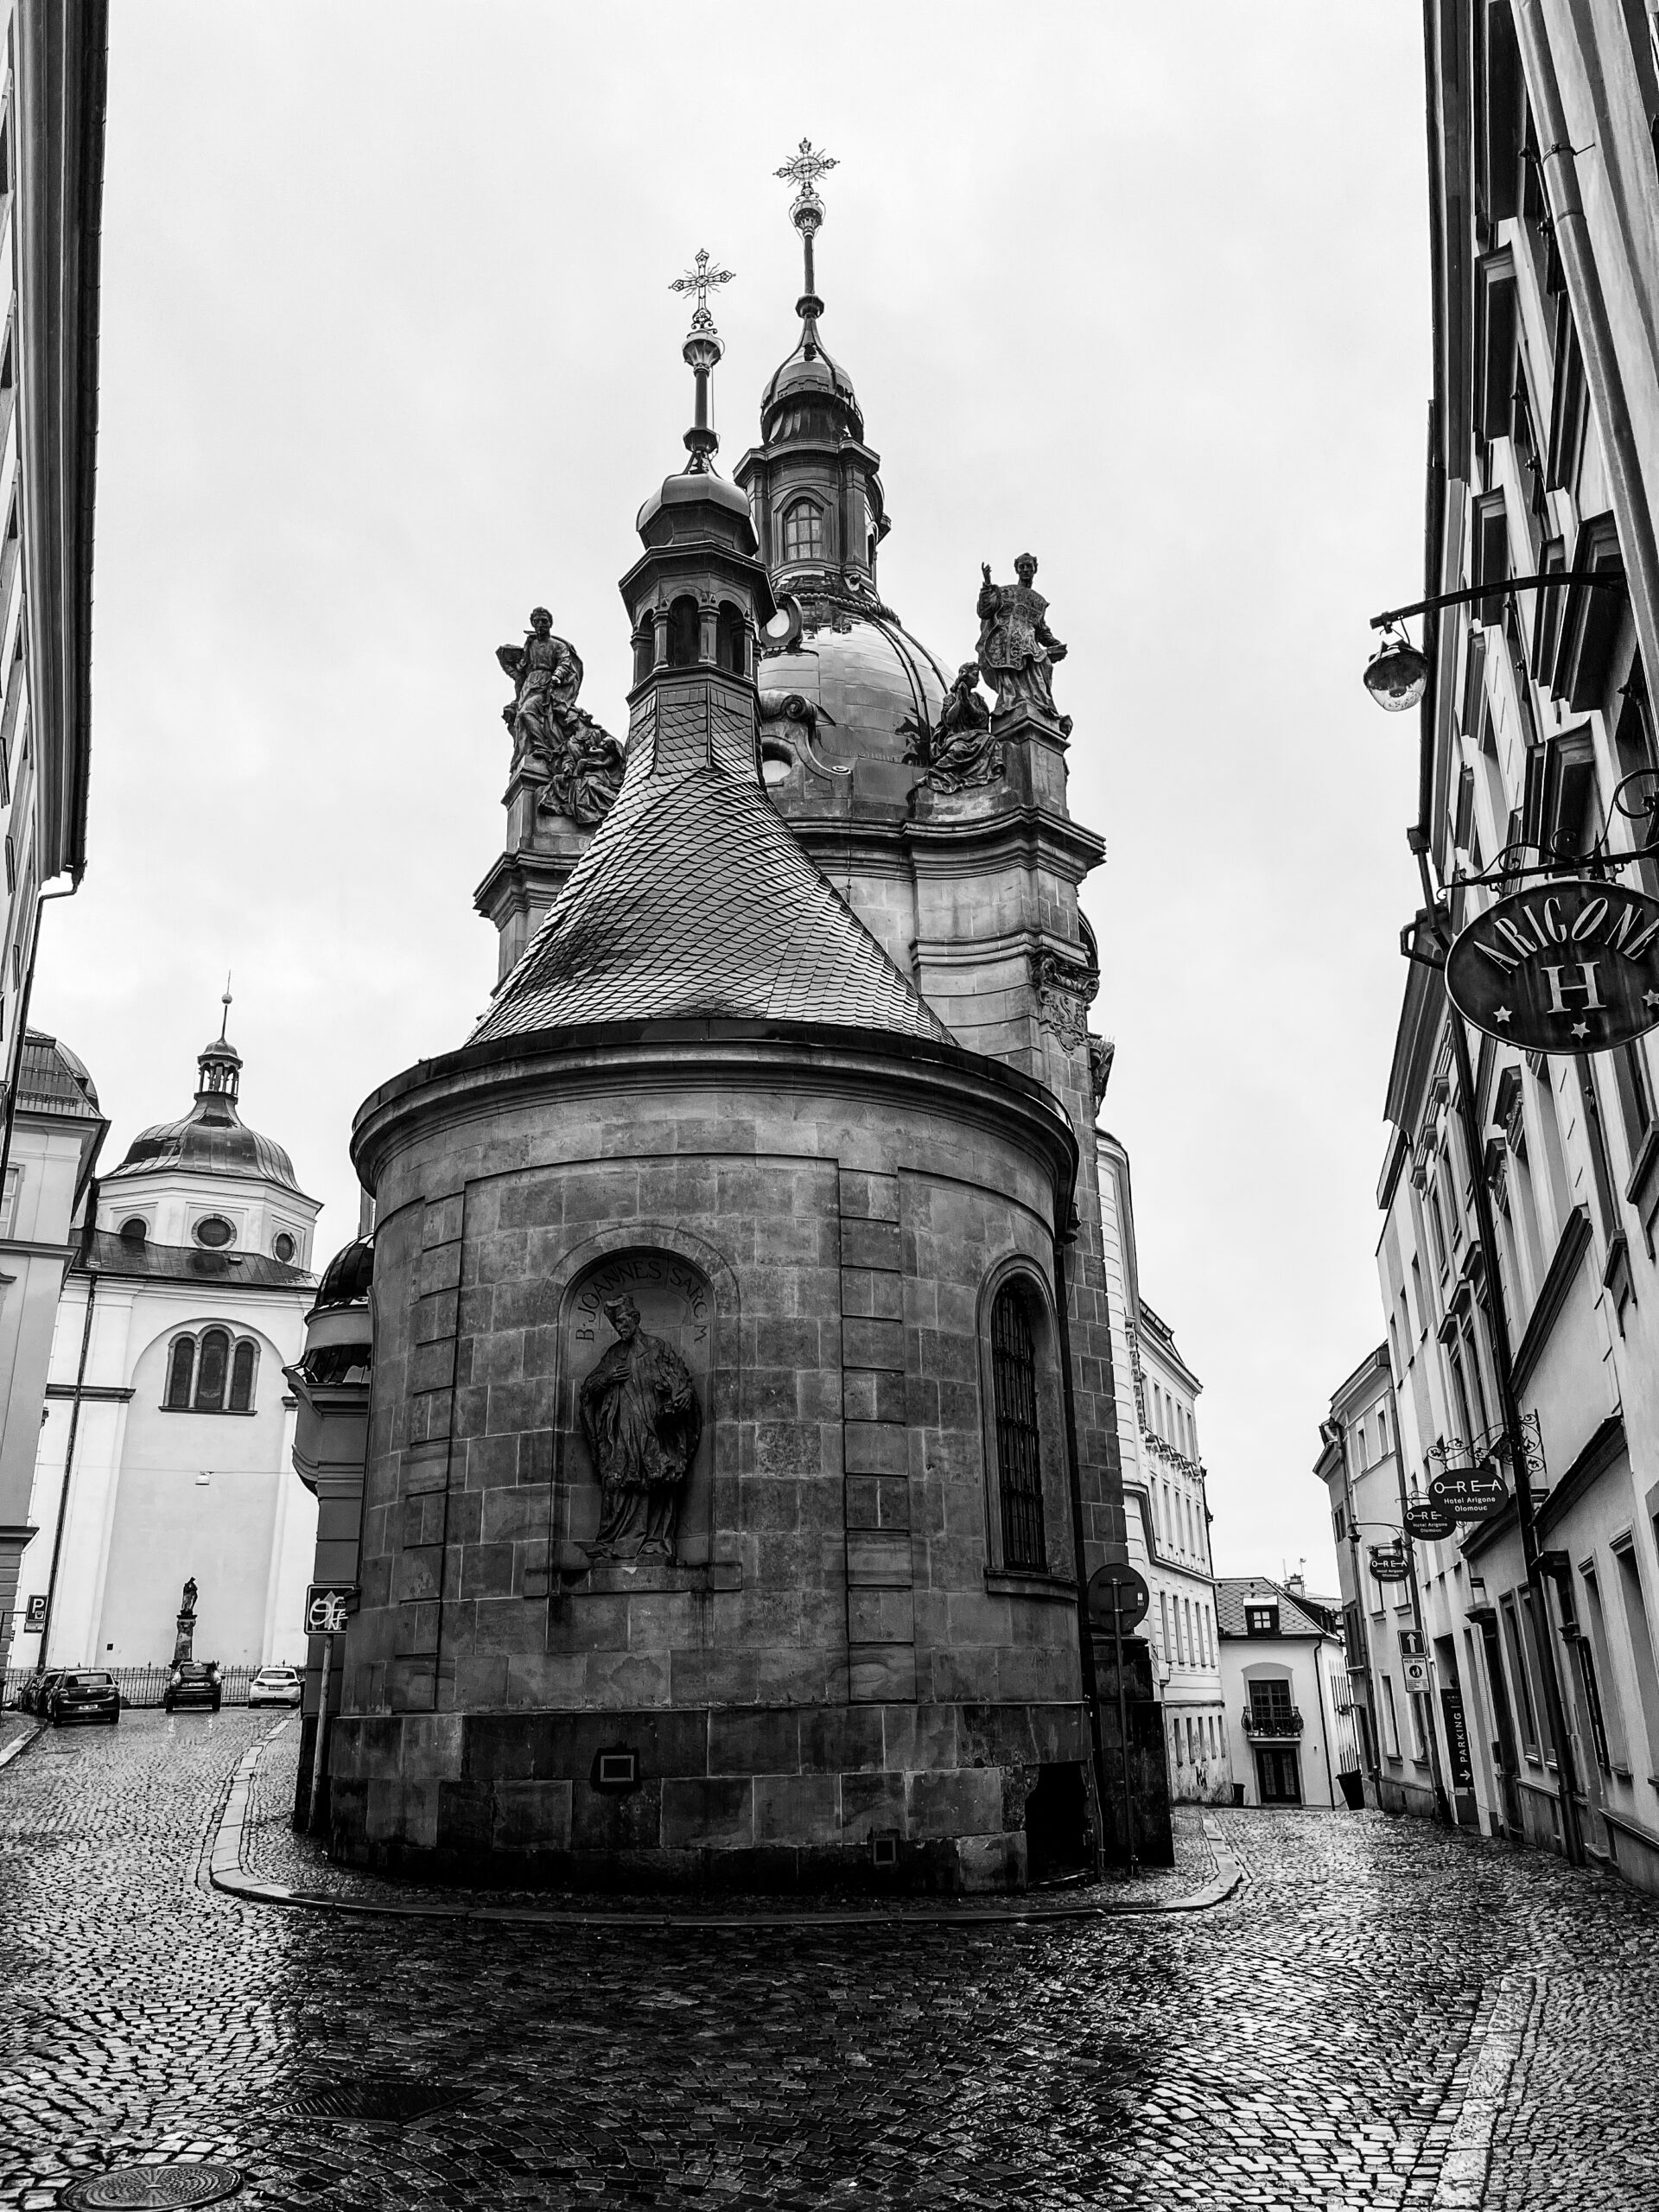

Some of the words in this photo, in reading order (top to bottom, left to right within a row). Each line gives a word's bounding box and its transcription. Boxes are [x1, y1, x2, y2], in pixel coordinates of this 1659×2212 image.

[1473, 897, 1659, 975] ARIGONE
[1541, 961, 1607, 1014] H
[577, 1262, 662, 1323] JOANNES
[32, 1599, 45, 1614] P
[1453, 1712, 1469, 1763] PARKING
